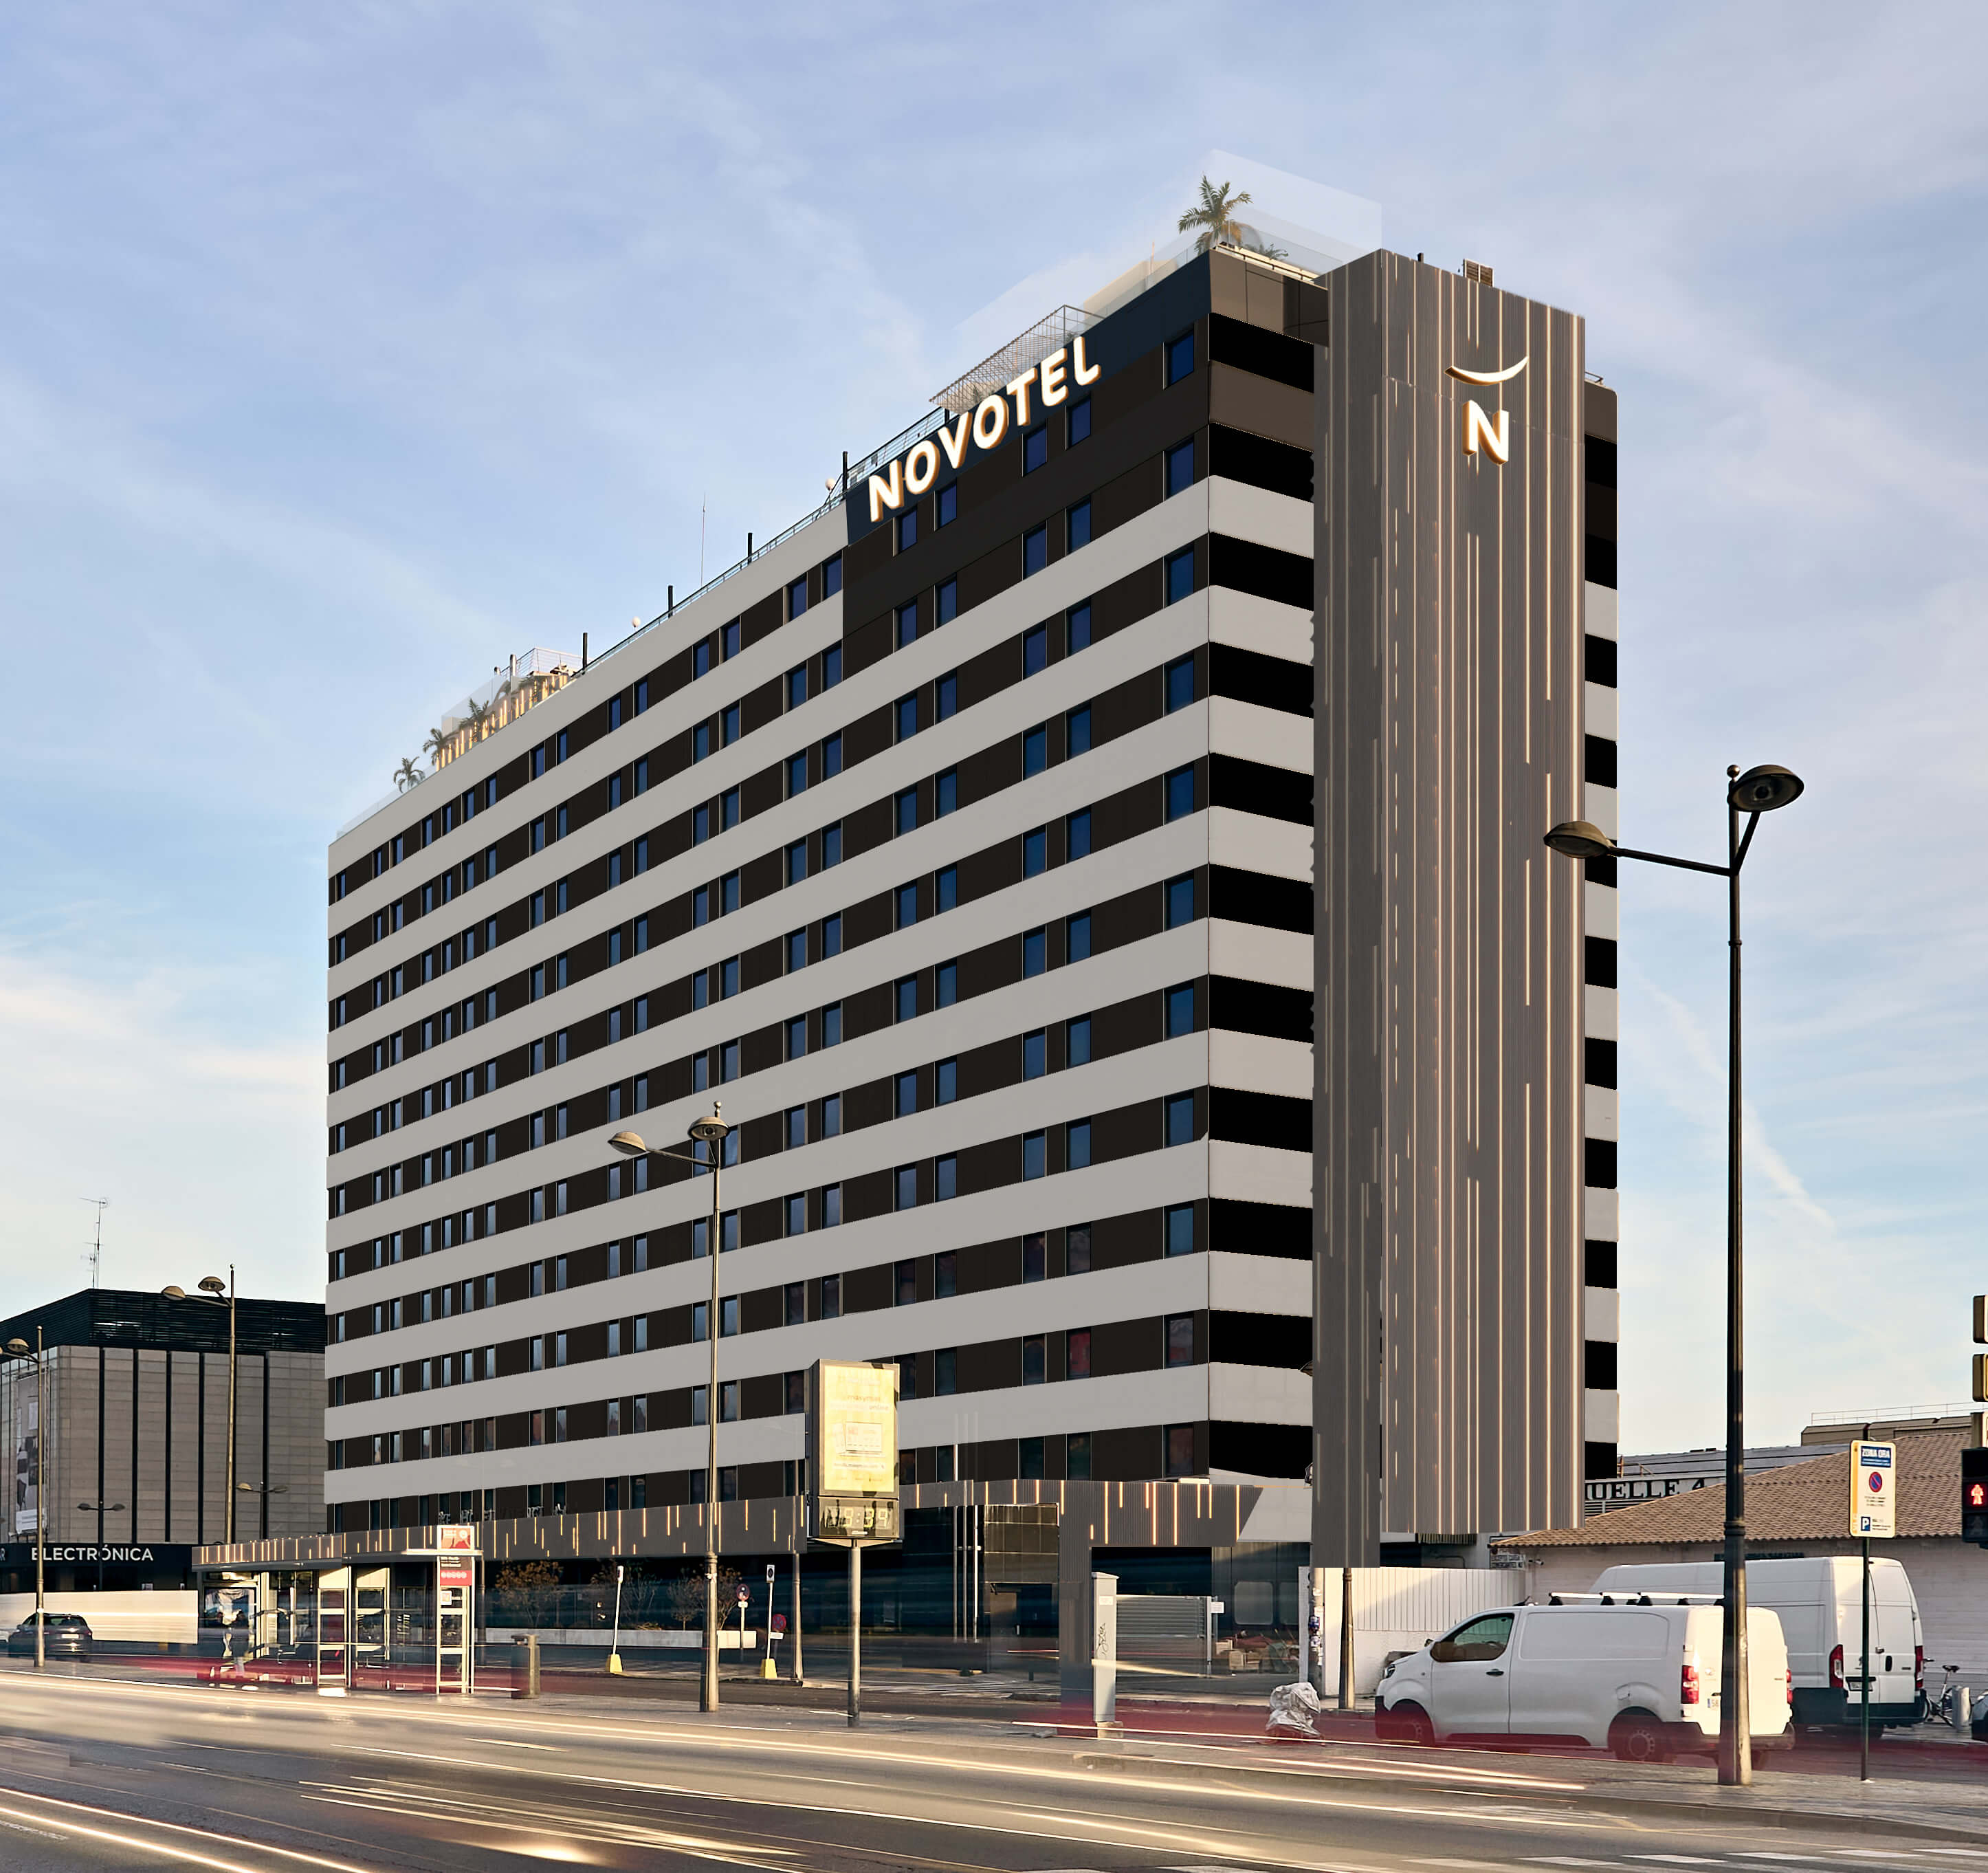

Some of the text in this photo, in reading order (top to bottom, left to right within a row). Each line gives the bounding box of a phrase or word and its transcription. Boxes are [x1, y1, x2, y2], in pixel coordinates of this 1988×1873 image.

[868, 336, 1101, 523] NOVOTEL
[1462, 399, 1510, 466] N
[1585, 1480, 1681, 1500] UELLE
[32, 1544, 154, 1561] ELECTRÓNICA
